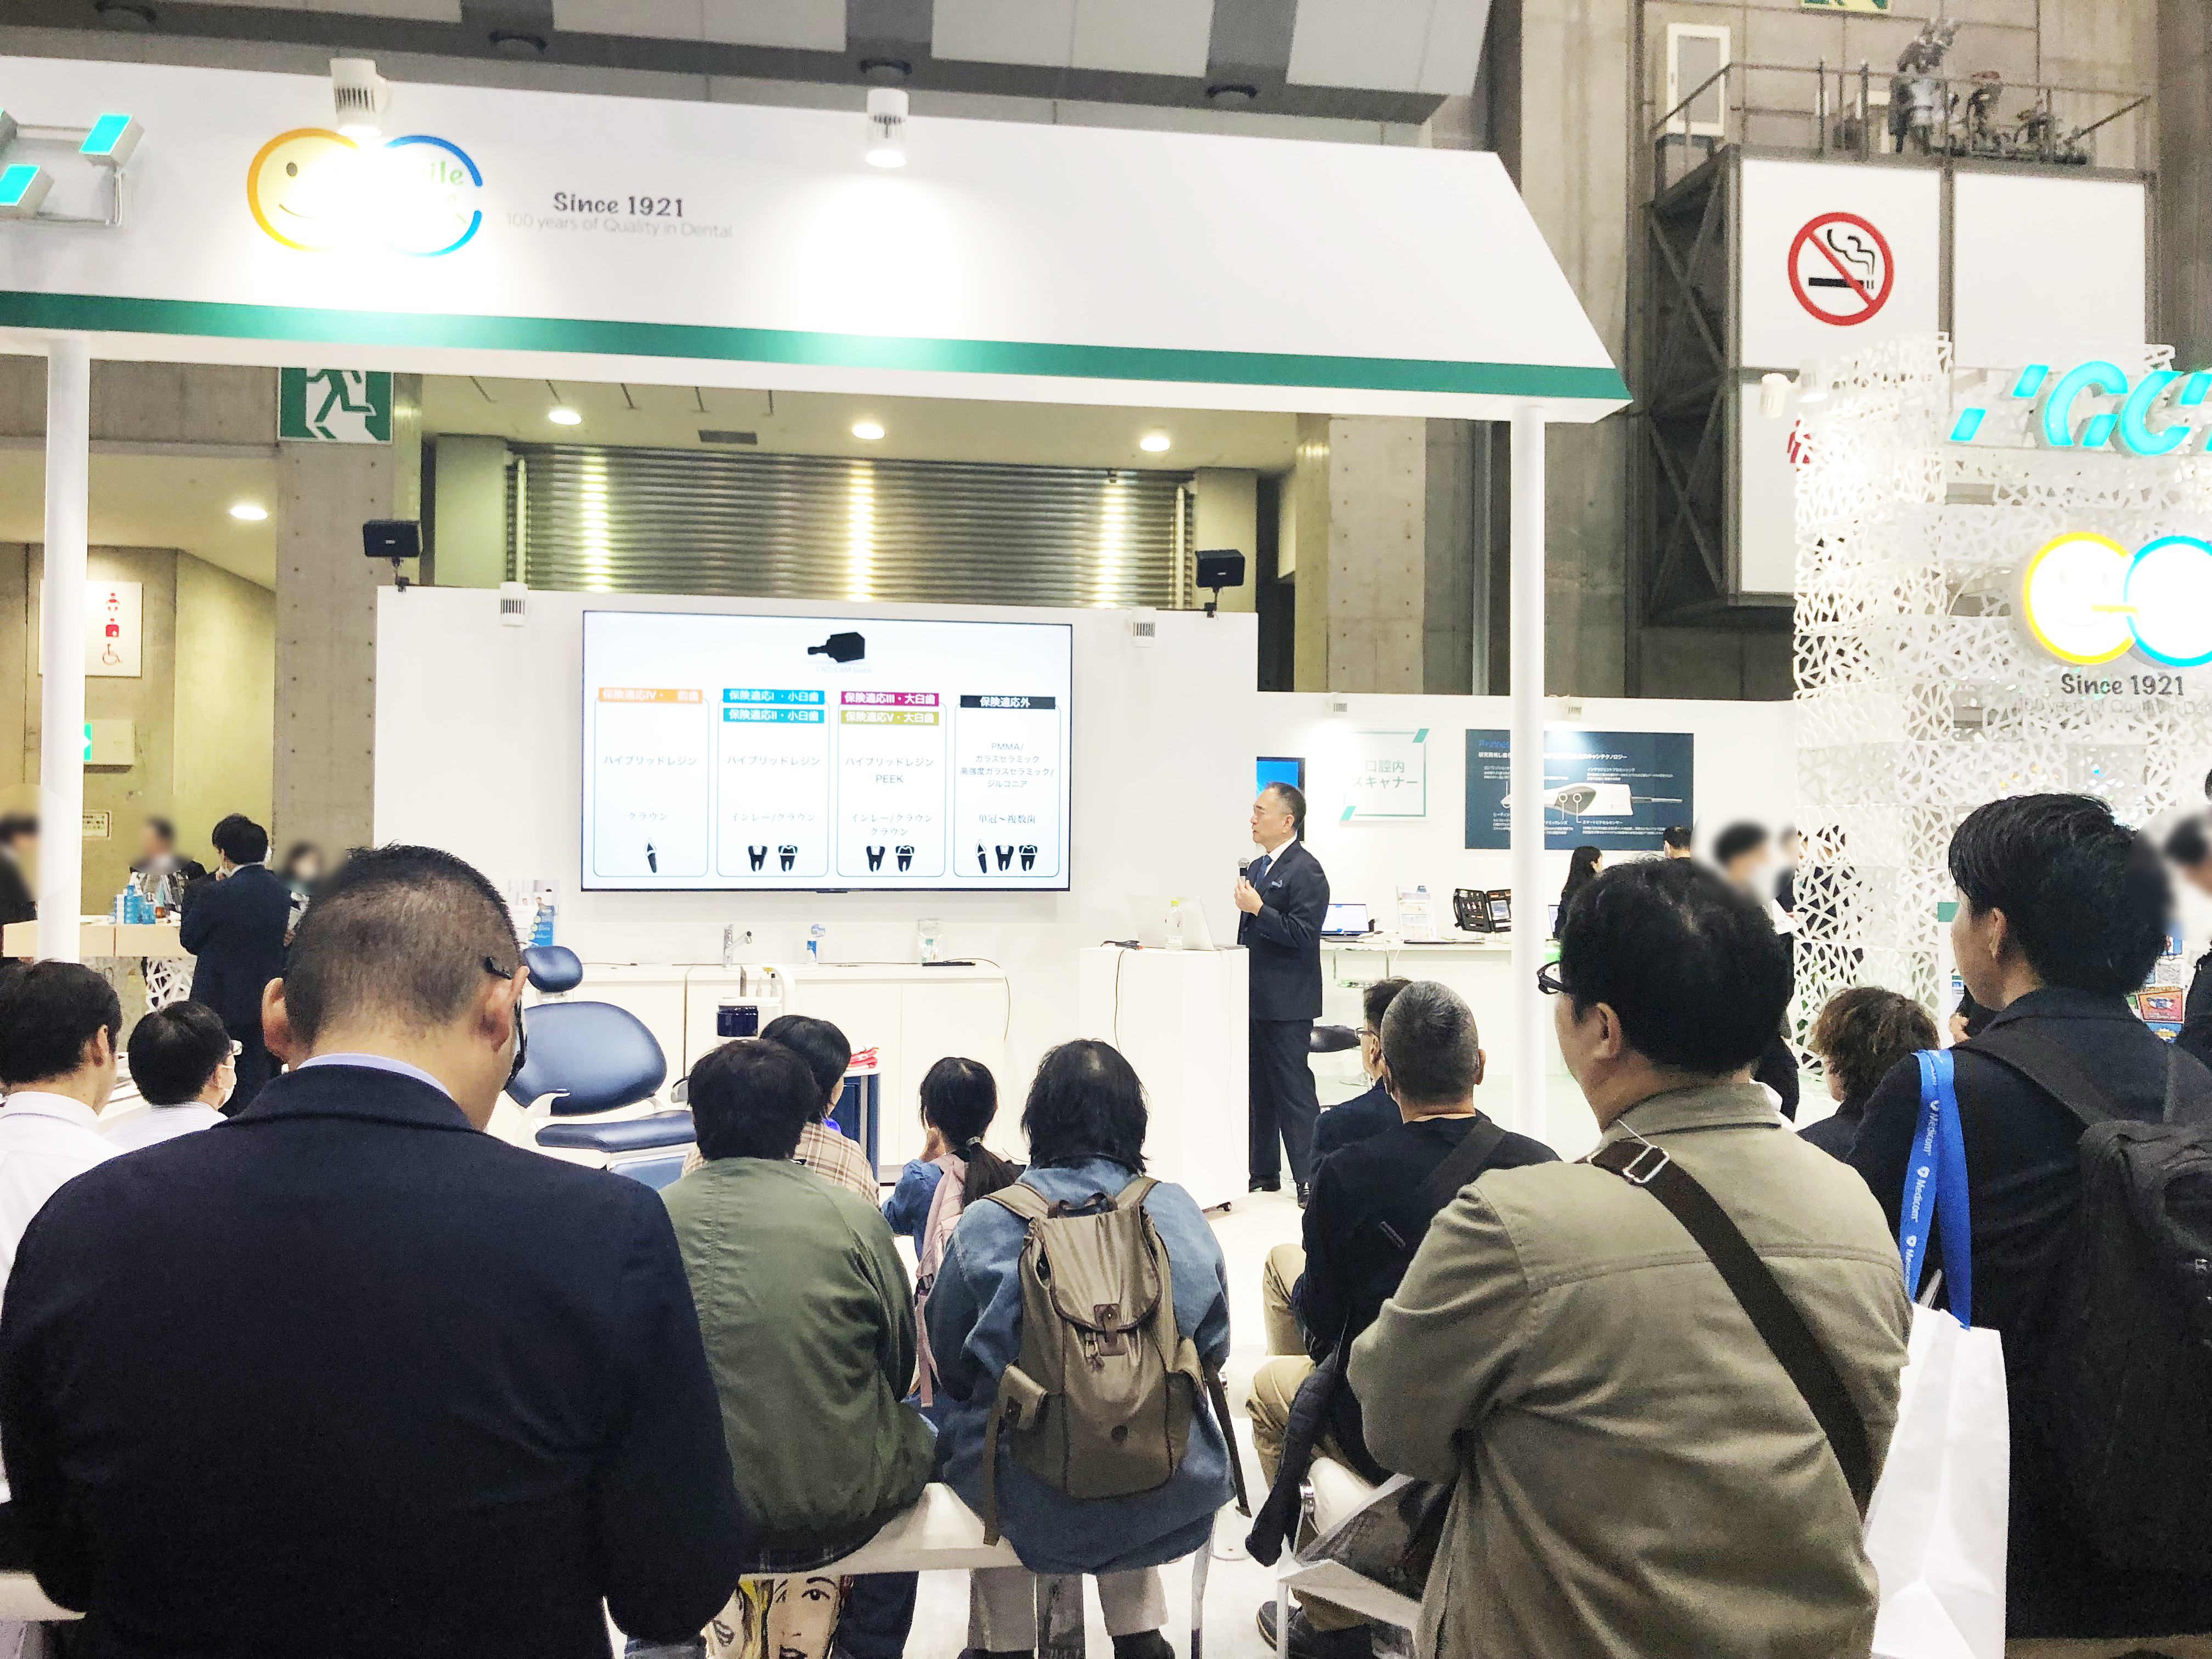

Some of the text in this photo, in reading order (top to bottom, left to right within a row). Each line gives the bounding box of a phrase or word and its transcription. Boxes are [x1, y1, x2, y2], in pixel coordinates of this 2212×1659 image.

[553, 191, 684, 217] Since 1921
[506, 213, 733, 239] 100 years of Quality in Dental
[2061, 673, 2184, 696] Since 1921
[979, 696, 1031, 708] 保険適応外
[603, 755, 697, 766] ハイブリッドレジン
[727, 755, 820, 766] ハイブリッドレジン
[845, 757, 934, 767] ハイブリッドレジン
[975, 755, 1040, 764] ガラスセラミック
[1365, 759, 1406, 773] 口腔内
[876, 774, 904, 784] PEEK
[987, 780, 1028, 788] ジルコニア
[1352, 776, 1418, 789] スキャナー
[628, 811, 668, 822] クラウン
[731, 811, 816, 823] インレー/クラウン
[850, 813, 934, 823] インレー/クラウン
[870, 827, 909, 837] クラウン
[1911, 1179, 1926, 1223] Medicom
